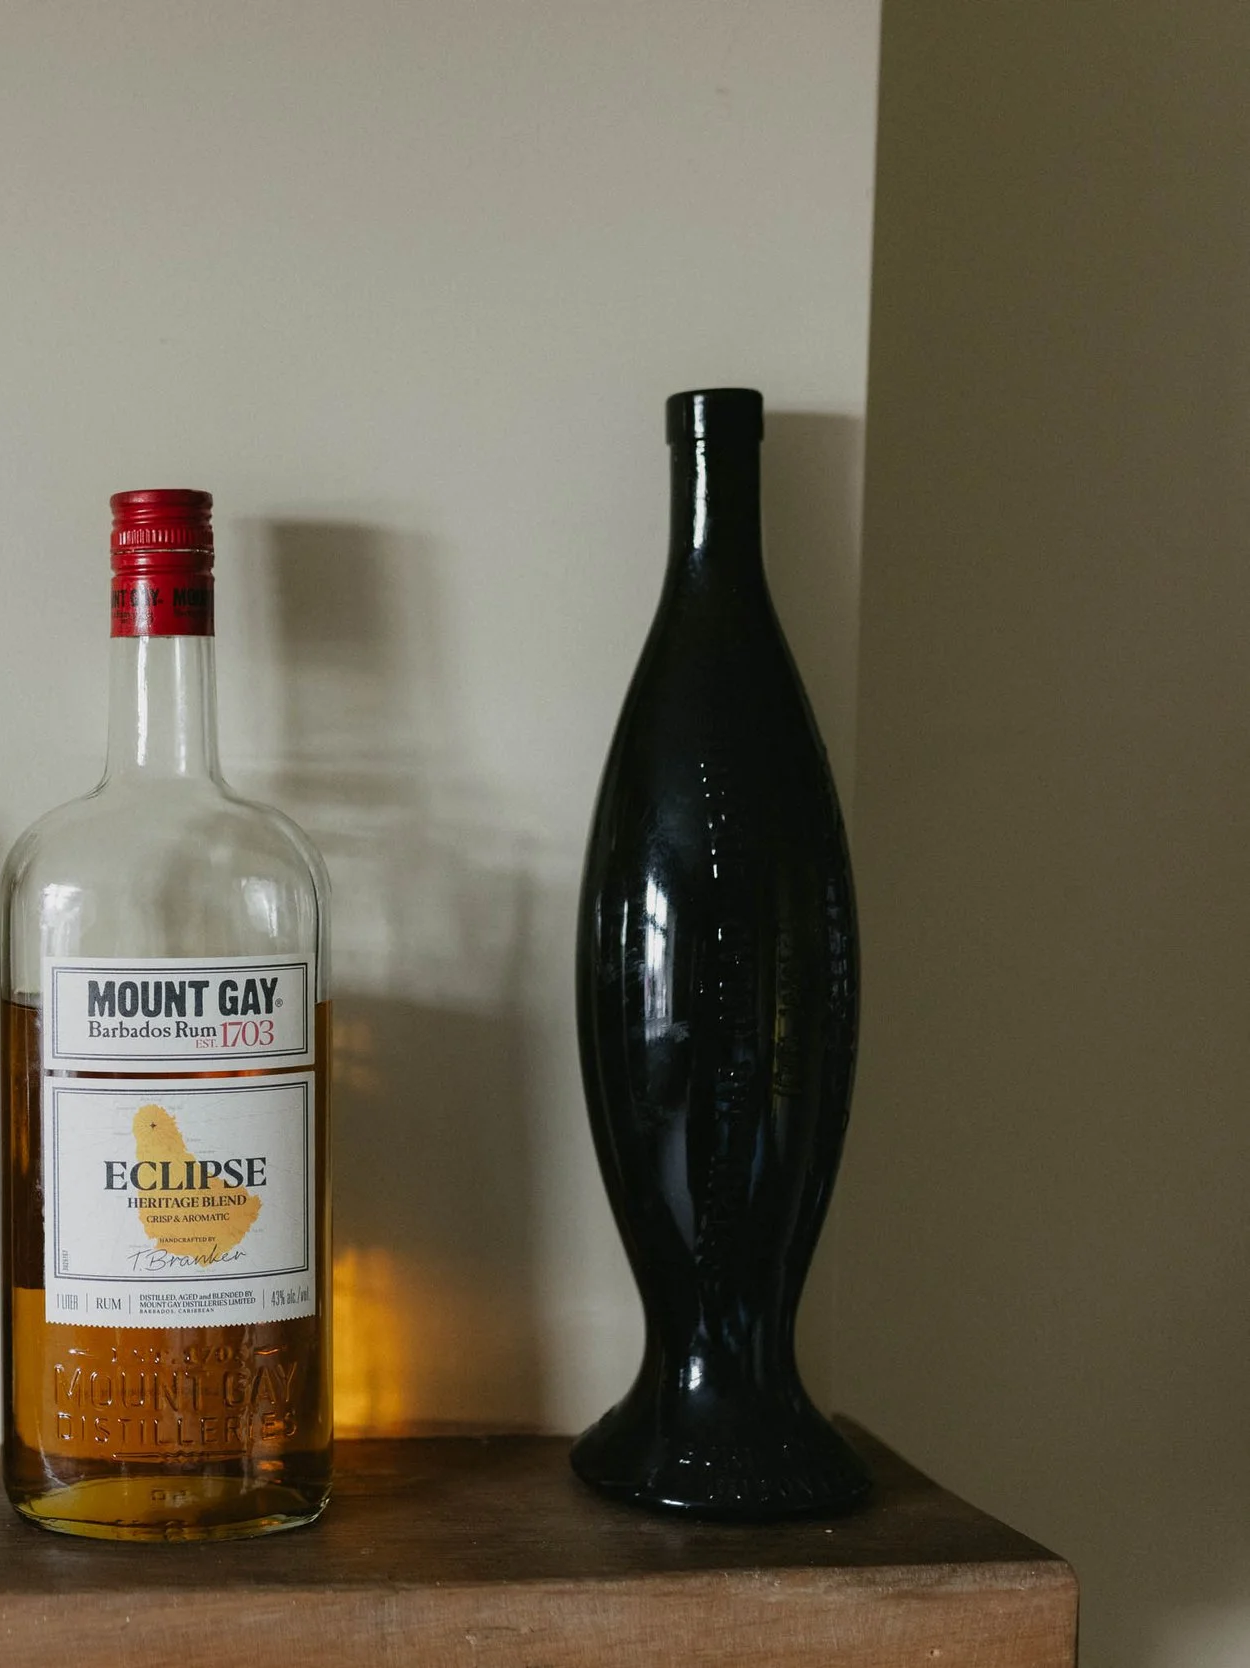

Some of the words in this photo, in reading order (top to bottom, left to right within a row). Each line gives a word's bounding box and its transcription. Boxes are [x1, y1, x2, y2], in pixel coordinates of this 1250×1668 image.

[88, 980, 210, 1018] MOUNT
[88, 1020, 171, 1038] Barbados
[175, 1020, 217, 1038] Rum
[195, 1038, 219, 1049] EST.
[221, 1019, 275, 1048] 1703
[103, 1157, 267, 1191] ECLIPSE
[127, 1196, 200, 1209] HERITAGE
[202, 1194, 247, 1207] BLEND
[146, 1214, 173, 1223] CRISP
[173, 1214, 181, 1223] &
[182, 1213, 230, 1223] AROMATIC
[159, 1236, 205, 1244] HANDCRAFTED
[212, 1291, 244, 1299] BLENDED
[245, 1290, 253, 1298] BY
[271, 1290, 285, 1306] 43%
[96, 1297, 122, 1310] RUM
[182, 1299, 228, 1308] DISTILLERIES
[53, 1363, 202, 1411] MOUNT
[56, 1411, 298, 1446] DISTILLERIES
